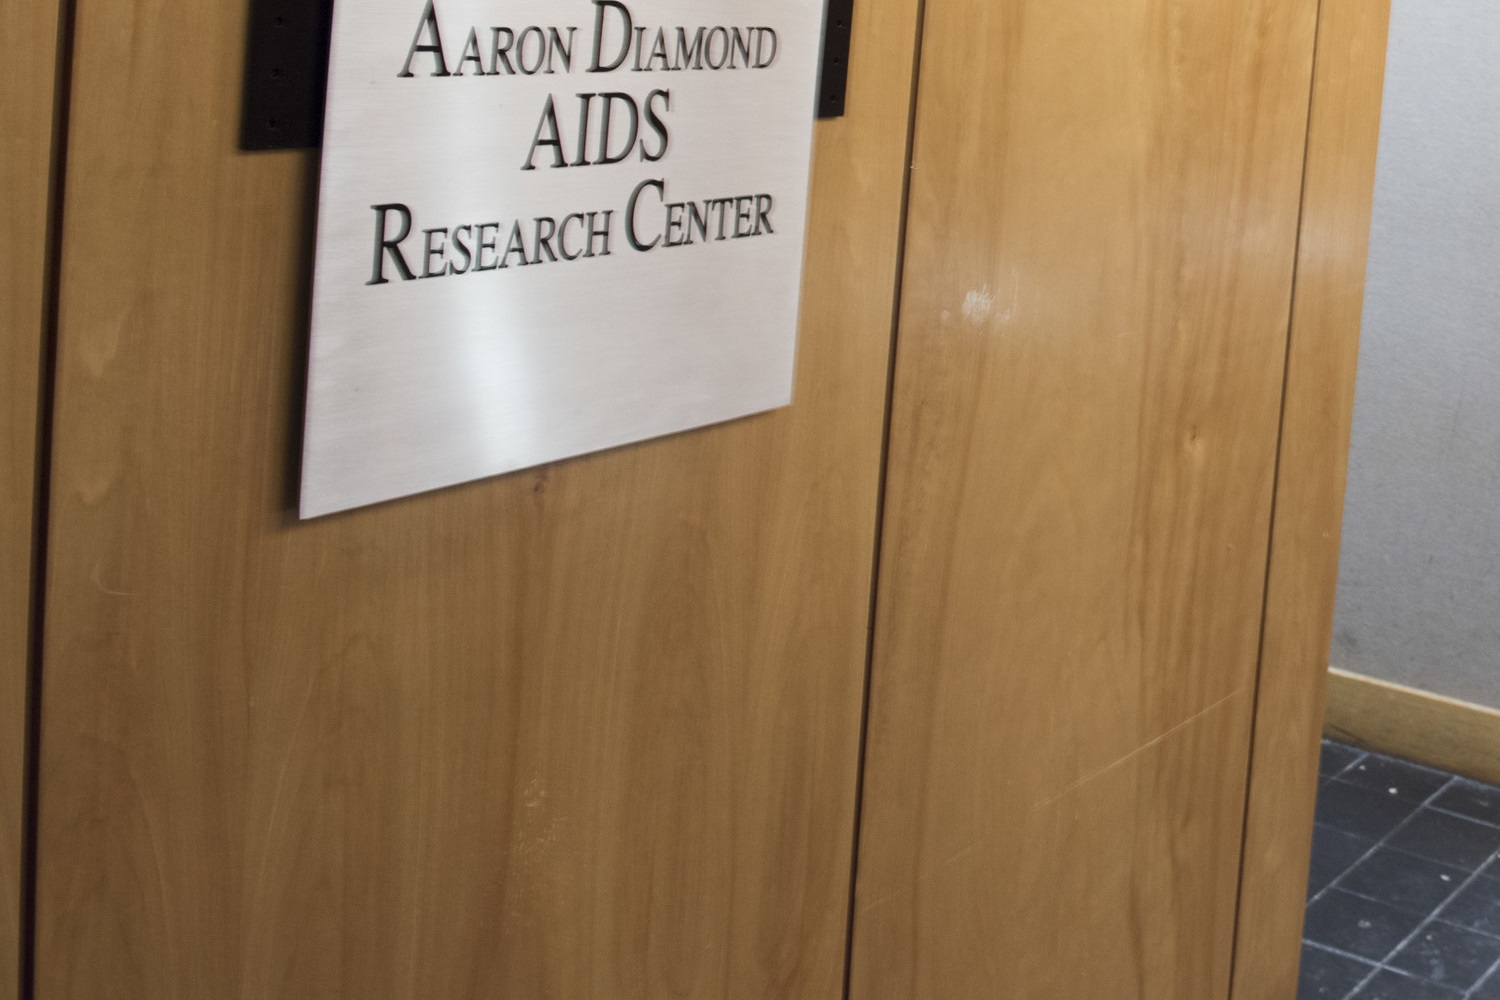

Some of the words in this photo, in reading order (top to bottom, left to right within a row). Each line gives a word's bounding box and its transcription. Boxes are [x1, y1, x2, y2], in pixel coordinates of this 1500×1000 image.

[520, 88, 671, 171] AIDS
[364, 202, 615, 286] RESEARCH
[624, 177, 776, 253] CENTER
